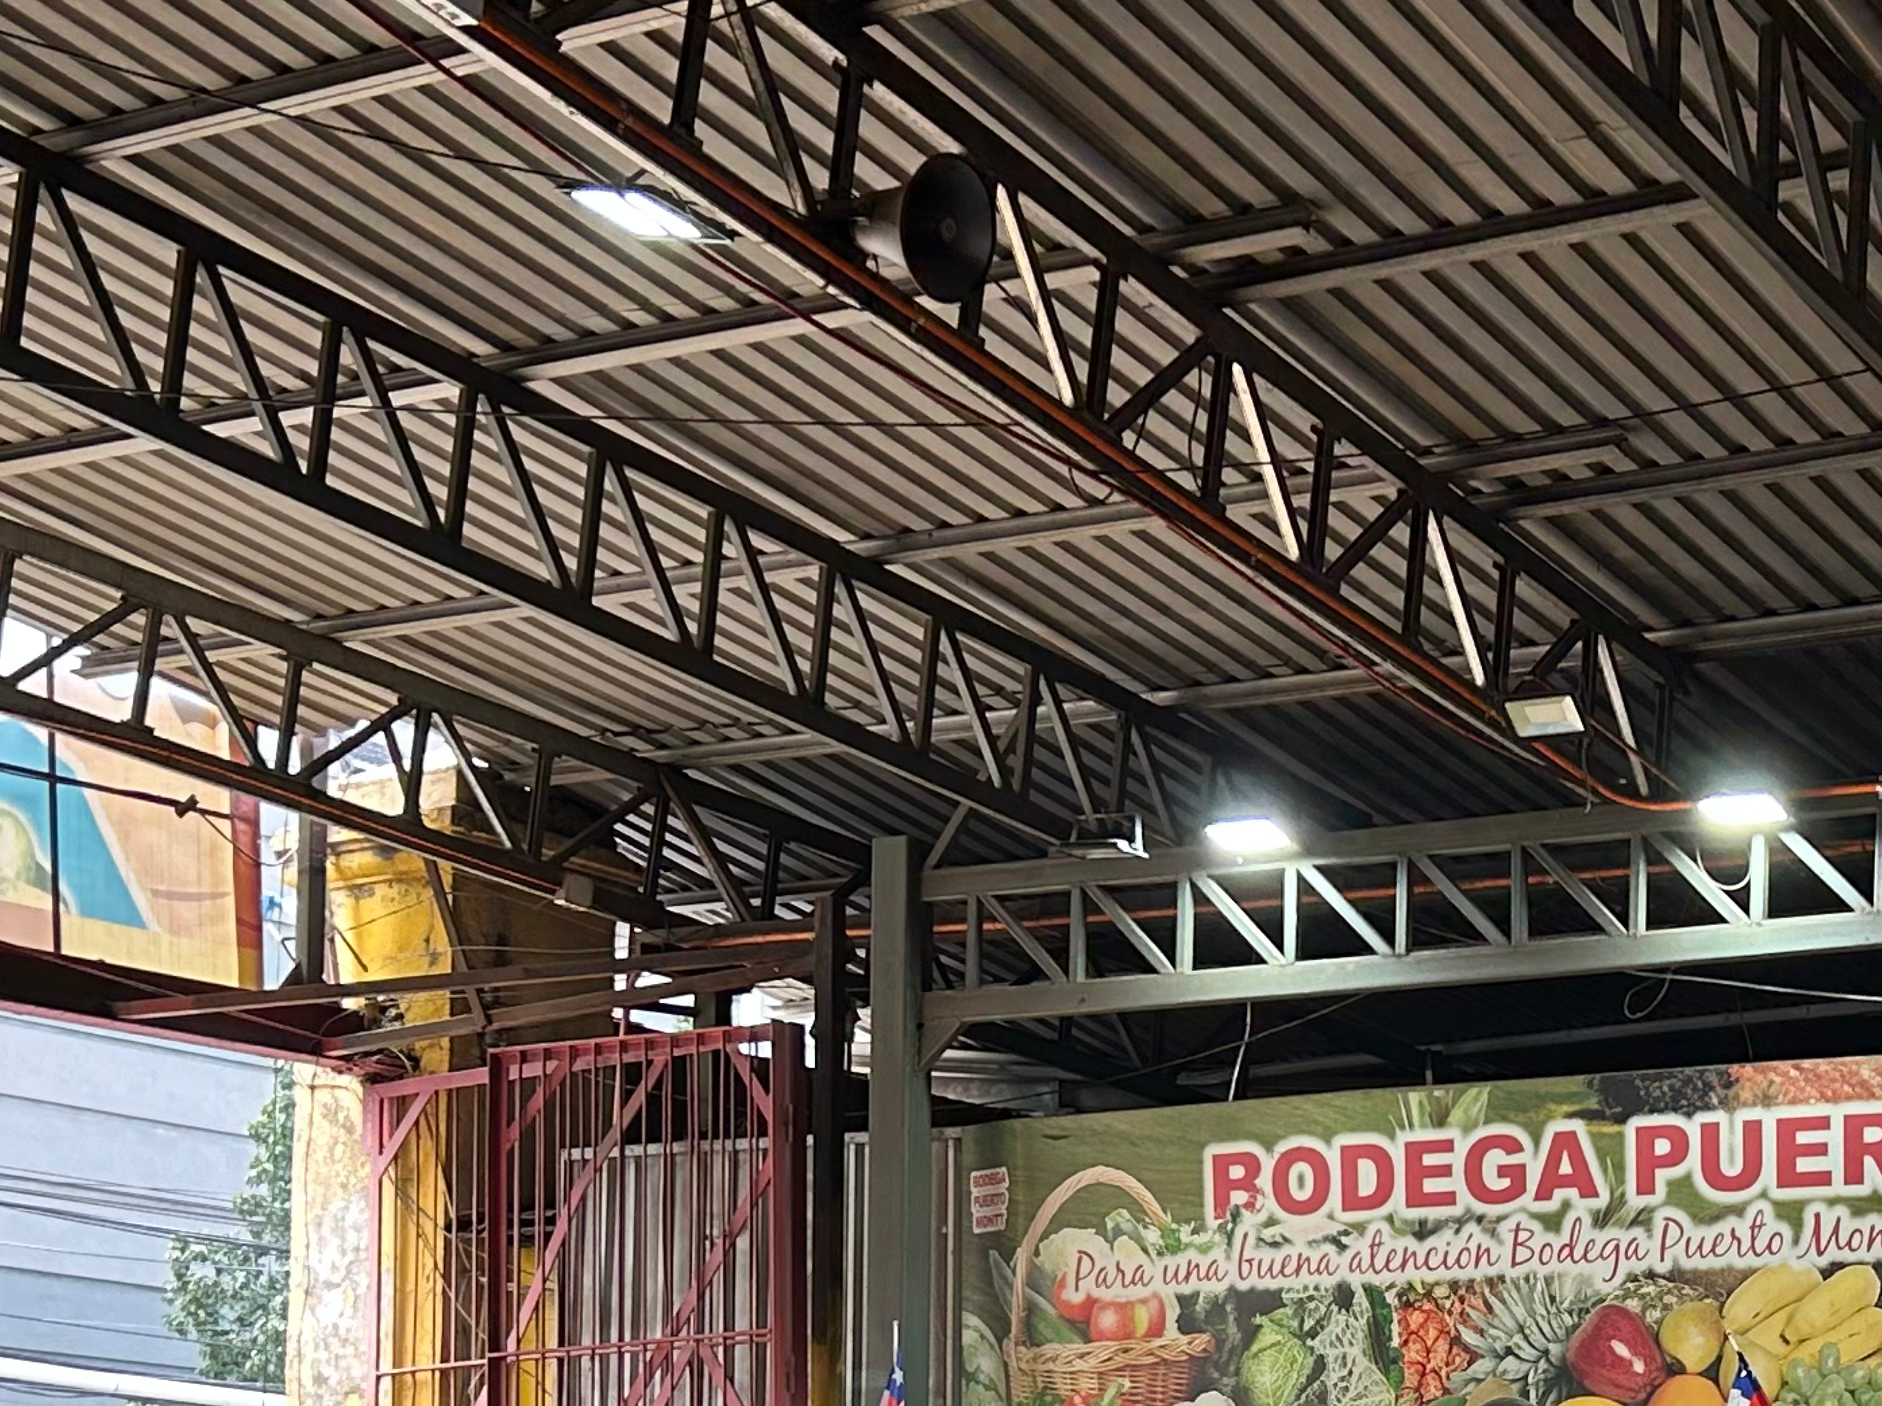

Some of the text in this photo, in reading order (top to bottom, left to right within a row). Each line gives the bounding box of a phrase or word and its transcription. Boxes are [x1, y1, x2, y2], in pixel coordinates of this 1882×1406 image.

[1212, 1130, 1599, 1221] BODEGA
[1074, 1250, 1154, 1292] Para
[1163, 1256, 1229, 1286] una
[1237, 1231, 1340, 1280] buena
[1348, 1228, 1500, 1274] atención
[1509, 1215, 1649, 1282] Bodega
[1659, 1209, 1784, 1263] Puerto
